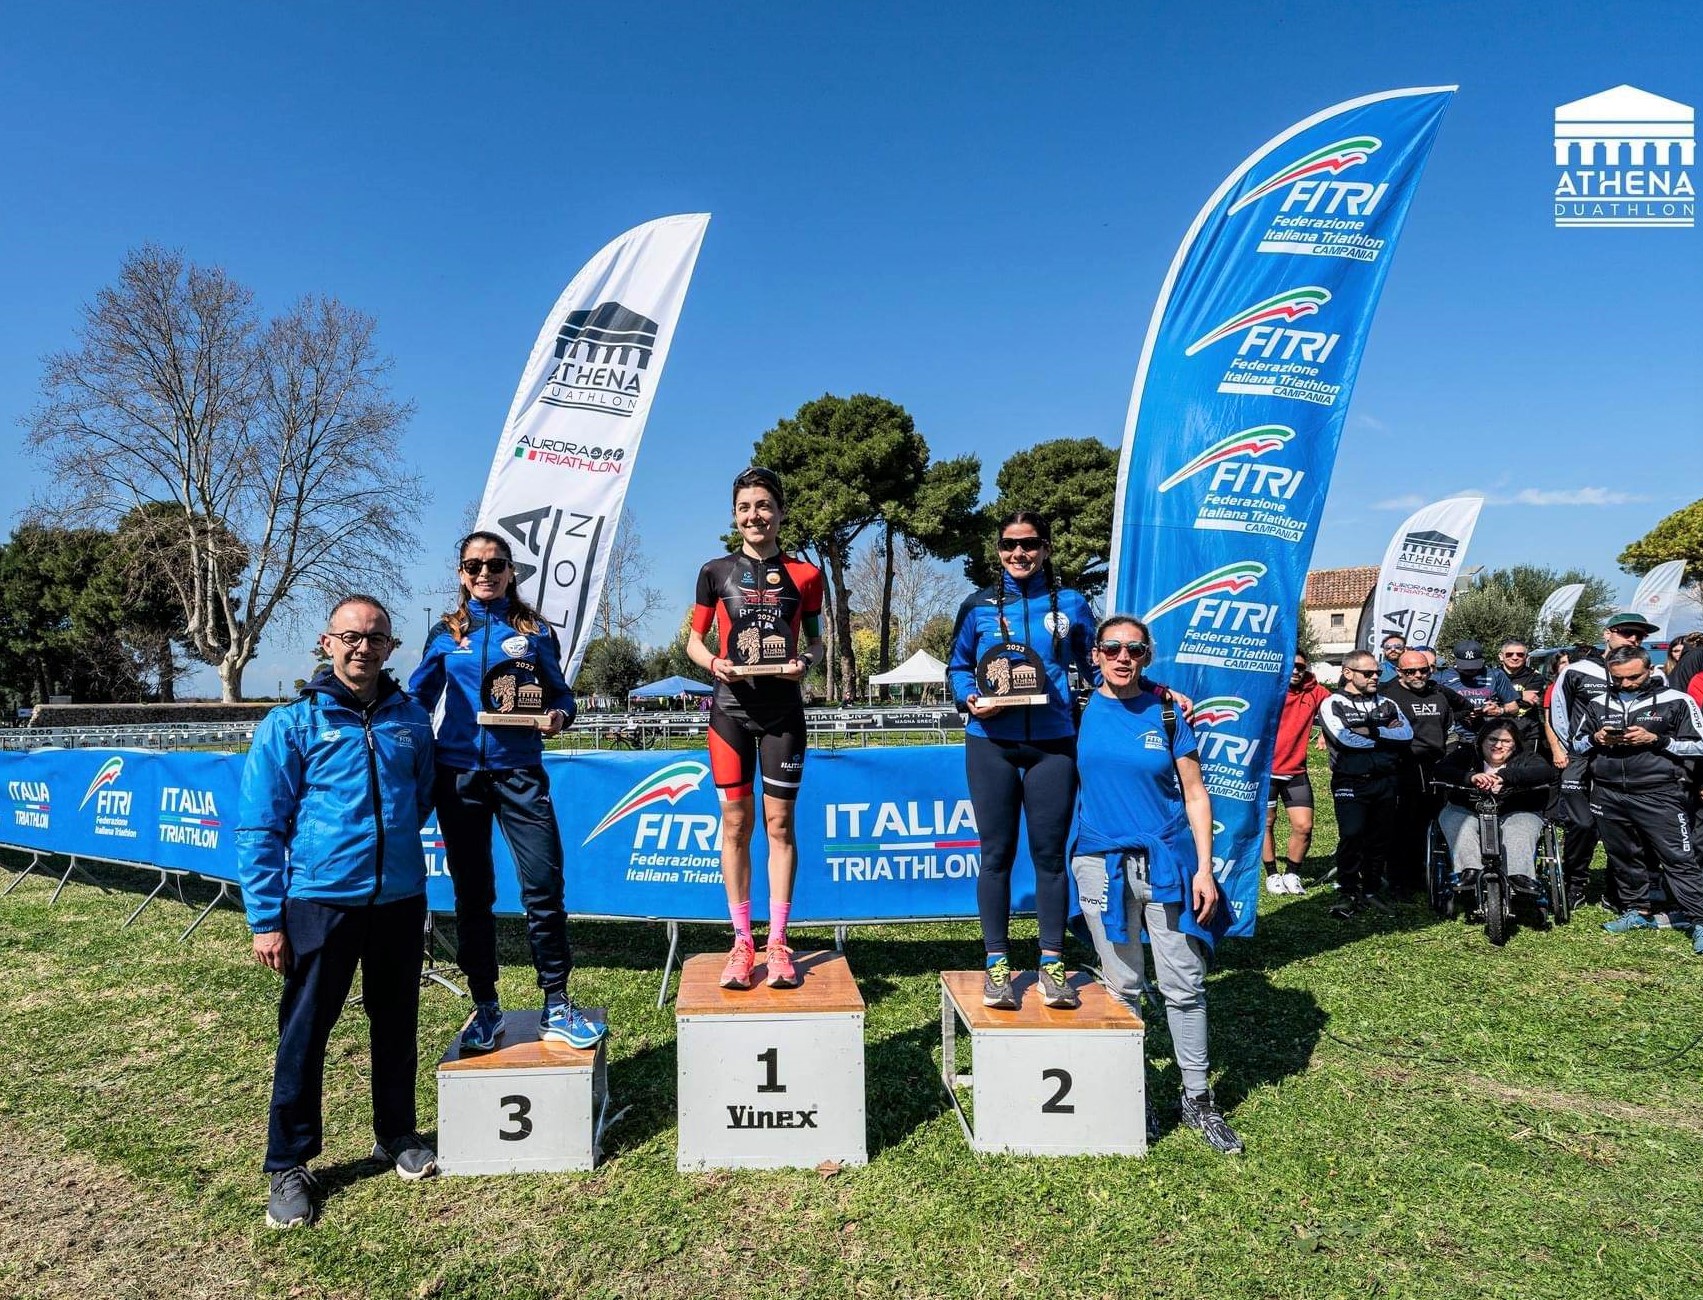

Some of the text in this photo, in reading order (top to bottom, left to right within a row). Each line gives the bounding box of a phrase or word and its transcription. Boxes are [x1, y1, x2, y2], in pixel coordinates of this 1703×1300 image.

[1280, 180, 1389, 216] FITRI
[1272, 215, 1365, 231] Federazione
[1264, 229, 1385, 249] Italiana Triathlon
[1312, 245, 1375, 260] CAMPANIA
[1237, 325, 1340, 363] FITRI
[1230, 358, 1319, 376] Federazione
[1223, 371, 1340, 394] Italiana Triathlon
[546, 386, 638, 409] UATHLON
[1272, 387, 1331, 404] CAMPANIA
[517, 435, 590, 458] AURORA
[539, 451, 622, 474] TRIATHLON
[1209, 462, 1305, 499] FITRI
[1204, 494, 1286, 512] Federazione
[1198, 507, 1307, 530] Italiana Triathlon
[1245, 523, 1299, 541] CAMPANIA
[1399, 553, 1451, 566] ATHENA
[757, 613, 776, 622] 2023
[1189, 598, 1279, 633] FITRI
[1184, 629, 1267, 647] Federazione
[1006, 644, 1025, 653] 2023
[1179, 642, 1283, 661] Italiana Triathlon
[515, 661, 535, 672] 2023
[1223, 659, 1279, 671] CAMPANIA
[1411, 703, 1437, 713] EA7
[1194, 732, 1260, 766] ITRI
[8, 781, 49, 802] ITALIA
[1208, 774, 1259, 791] Triathlon
[97, 790, 133, 815] FITRI
[161, 787, 218, 816] ITALIA
[1207, 786, 1256, 800] AMPANIA
[15, 810, 48, 829] TRIATHLON
[96, 816, 128, 826] Federazione
[826, 799, 979, 838] ITALIA
[159, 824, 218, 849] TRIATHLON
[630, 852, 720, 868] Federazione
[826, 853, 982, 882] TRIATHLON
[626, 868, 725, 884] Italiana Triath
[757, 1047, 787, 1093] 1
[1041, 1068, 1075, 1114] 2
[498, 1094, 533, 1142] 3
[727, 1105, 818, 1129] Vinex
